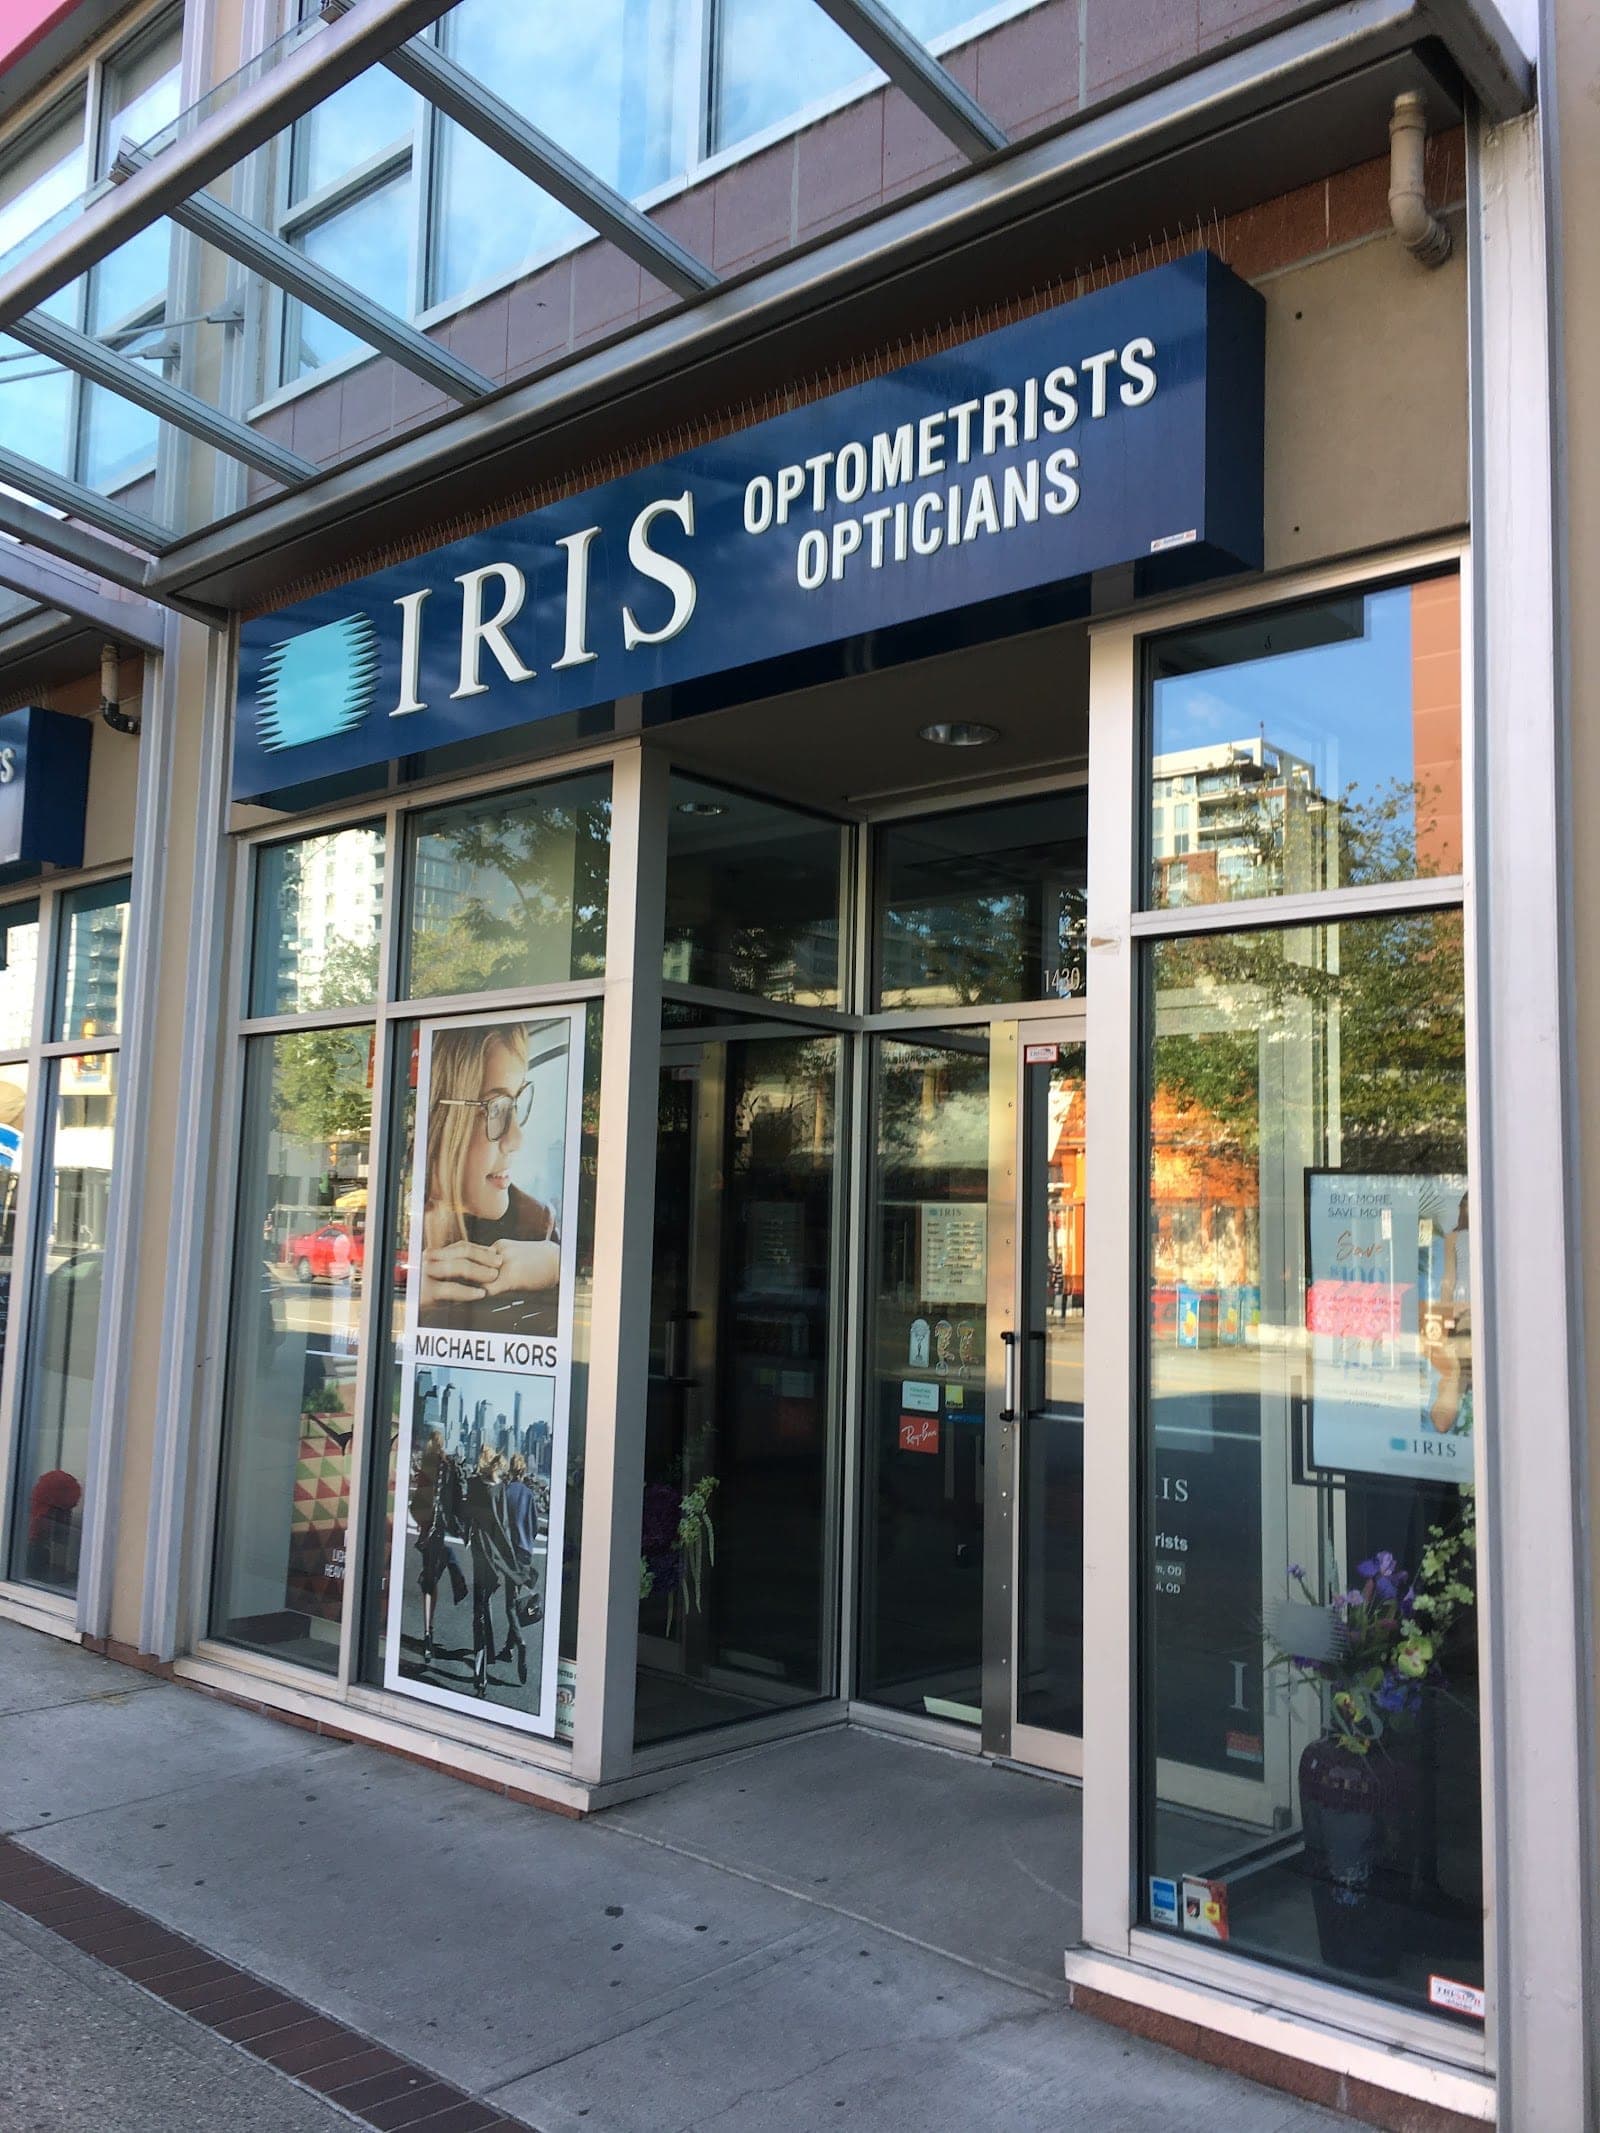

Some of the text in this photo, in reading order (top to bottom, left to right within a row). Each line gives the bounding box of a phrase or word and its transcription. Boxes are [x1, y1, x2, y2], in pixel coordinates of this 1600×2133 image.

[743, 336, 1158, 535] OPTOMETRISTS
[796, 447, 1081, 591] OPTICIANS
[388, 490, 698, 718] IRIS
[1043, 966, 1081, 993] 1430
[415, 1334, 558, 1369] MICHAEL KORS
[1412, 1438, 1457, 1458] IRIS
